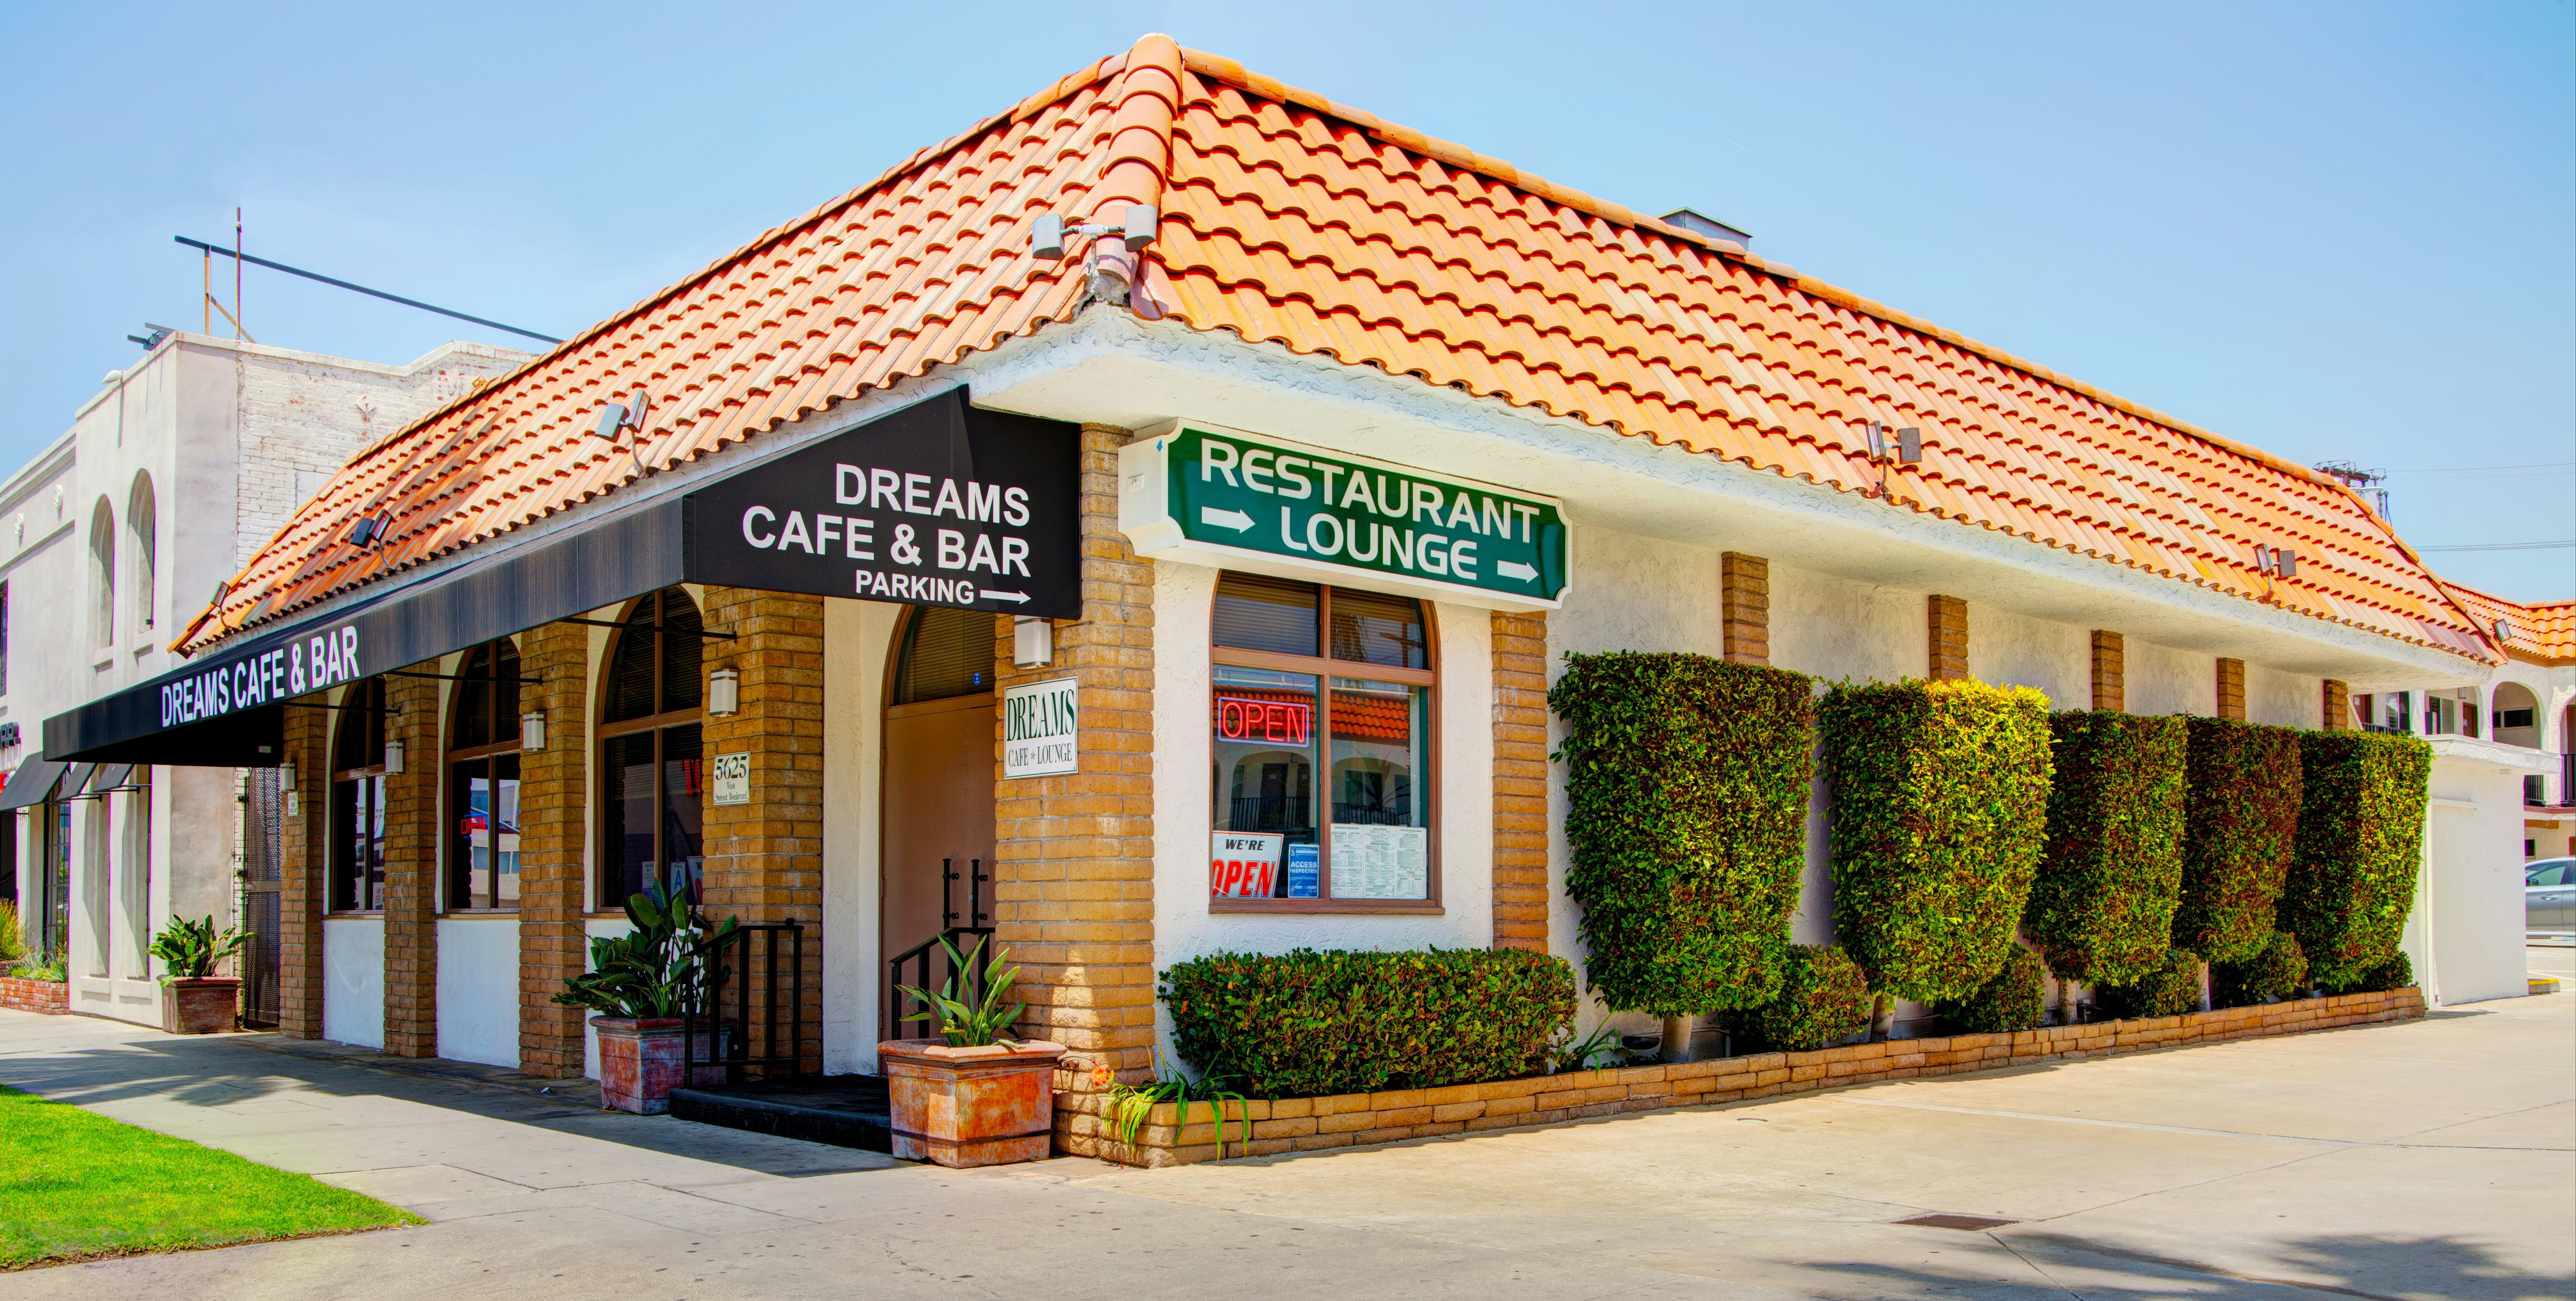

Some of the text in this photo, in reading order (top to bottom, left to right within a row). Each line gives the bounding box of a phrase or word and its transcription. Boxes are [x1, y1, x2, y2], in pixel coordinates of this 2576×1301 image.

[836, 463, 1030, 527] DREAMS
[1201, 438, 1540, 543] RESTAURANT
[742, 506, 1031, 578] CAFE & BAR
[1281, 506, 1477, 581] LOUNGE
[856, 569, 975, 605] PARKING
[162, 625, 360, 728] DREAMS CAFE & BAR
[1006, 689, 1075, 742] DREAMS
[1223, 701, 1305, 743] OPEN
[0, 722, 21, 750] RP.
[715, 756, 747, 780] 5625
[1008, 743, 1072, 767] CAFE LOUNGE
[716, 790, 747, 801] Sunset Boulevard
[726, 781, 736, 790] West
[1225, 839, 1265, 851] WE'RE
[674, 869, 683, 890] A
[1213, 858, 1277, 897] OPEN
